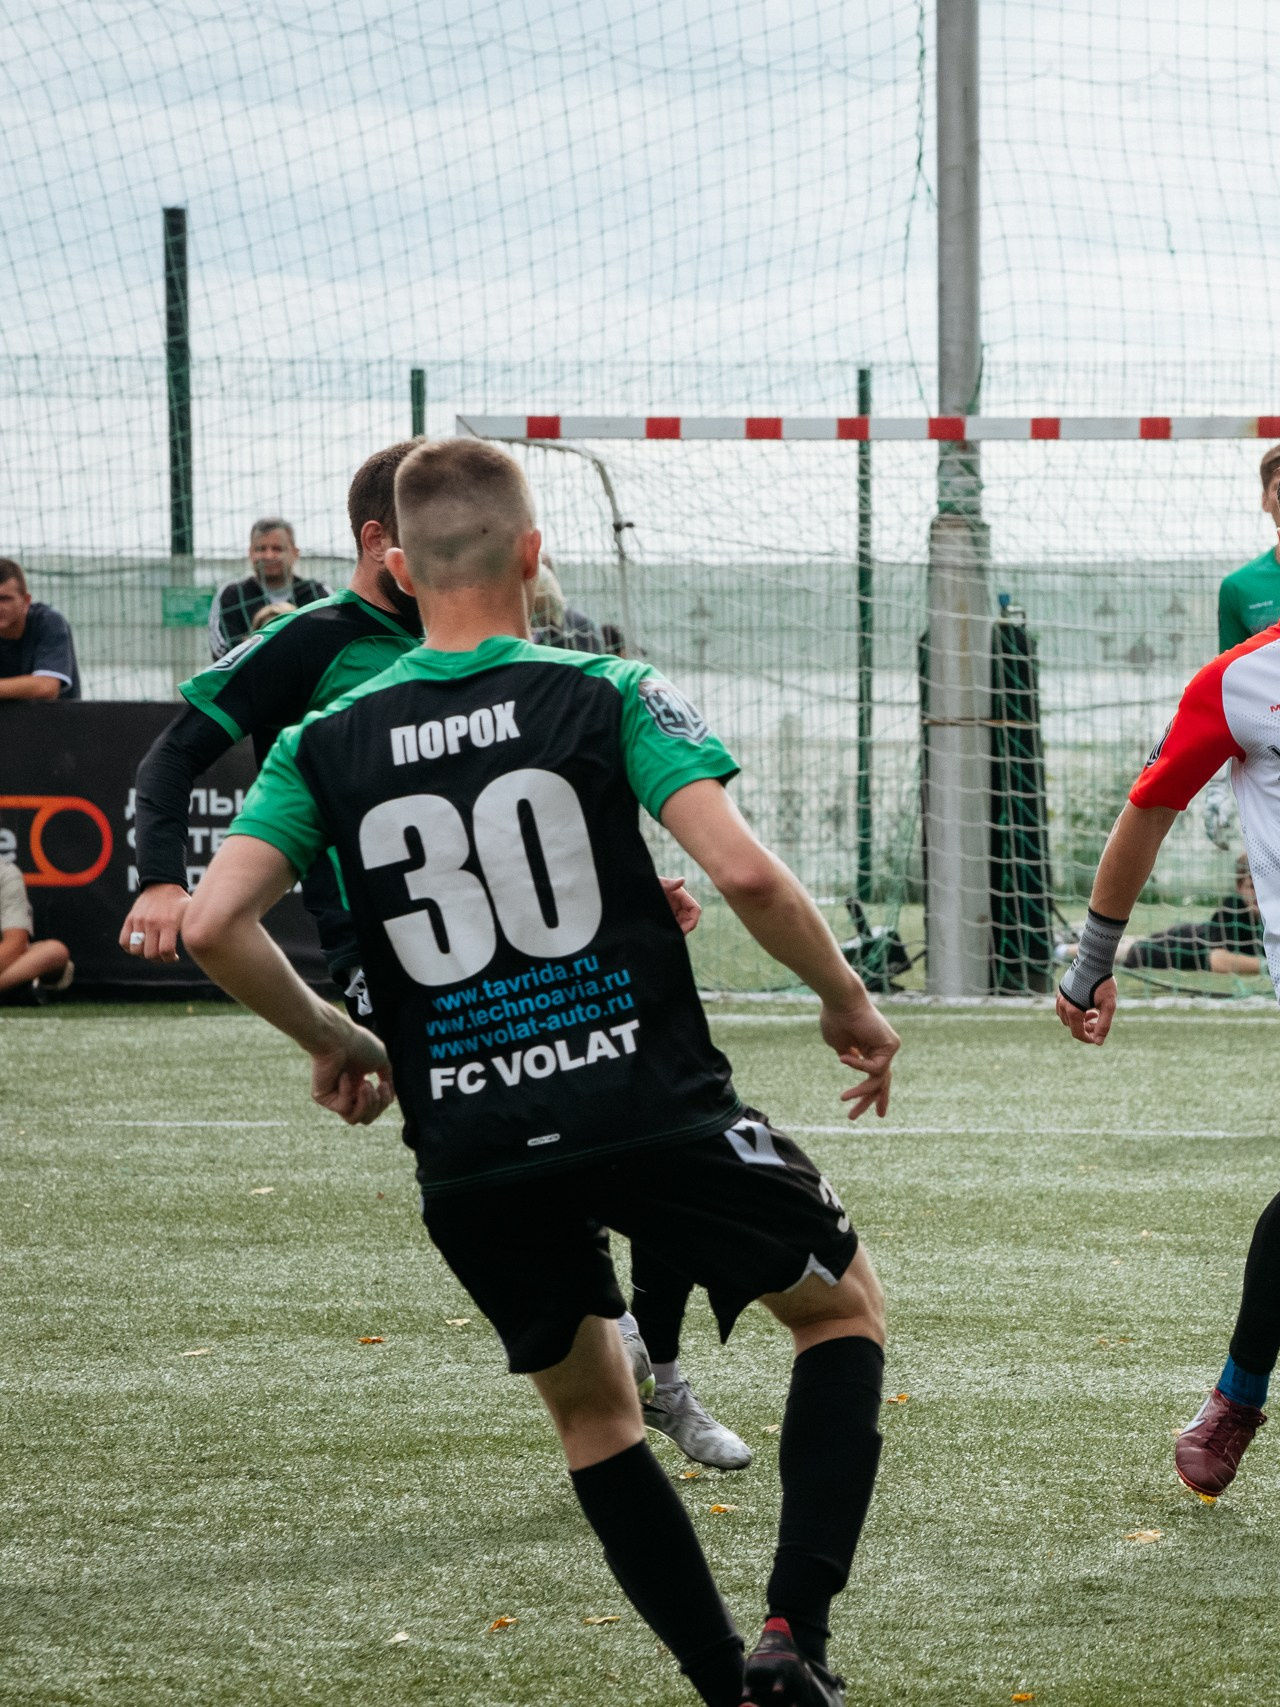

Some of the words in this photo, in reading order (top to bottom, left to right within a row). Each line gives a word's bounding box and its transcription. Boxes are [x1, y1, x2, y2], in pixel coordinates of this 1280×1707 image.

[390, 701, 521, 766] ПОРОХ
[359, 768, 602, 986] 30
[429, 993, 634, 1059] wwwvolat-auto.ru
[430, 1062, 487, 1100] FC
[491, 1019, 640, 1087] VOLAT
